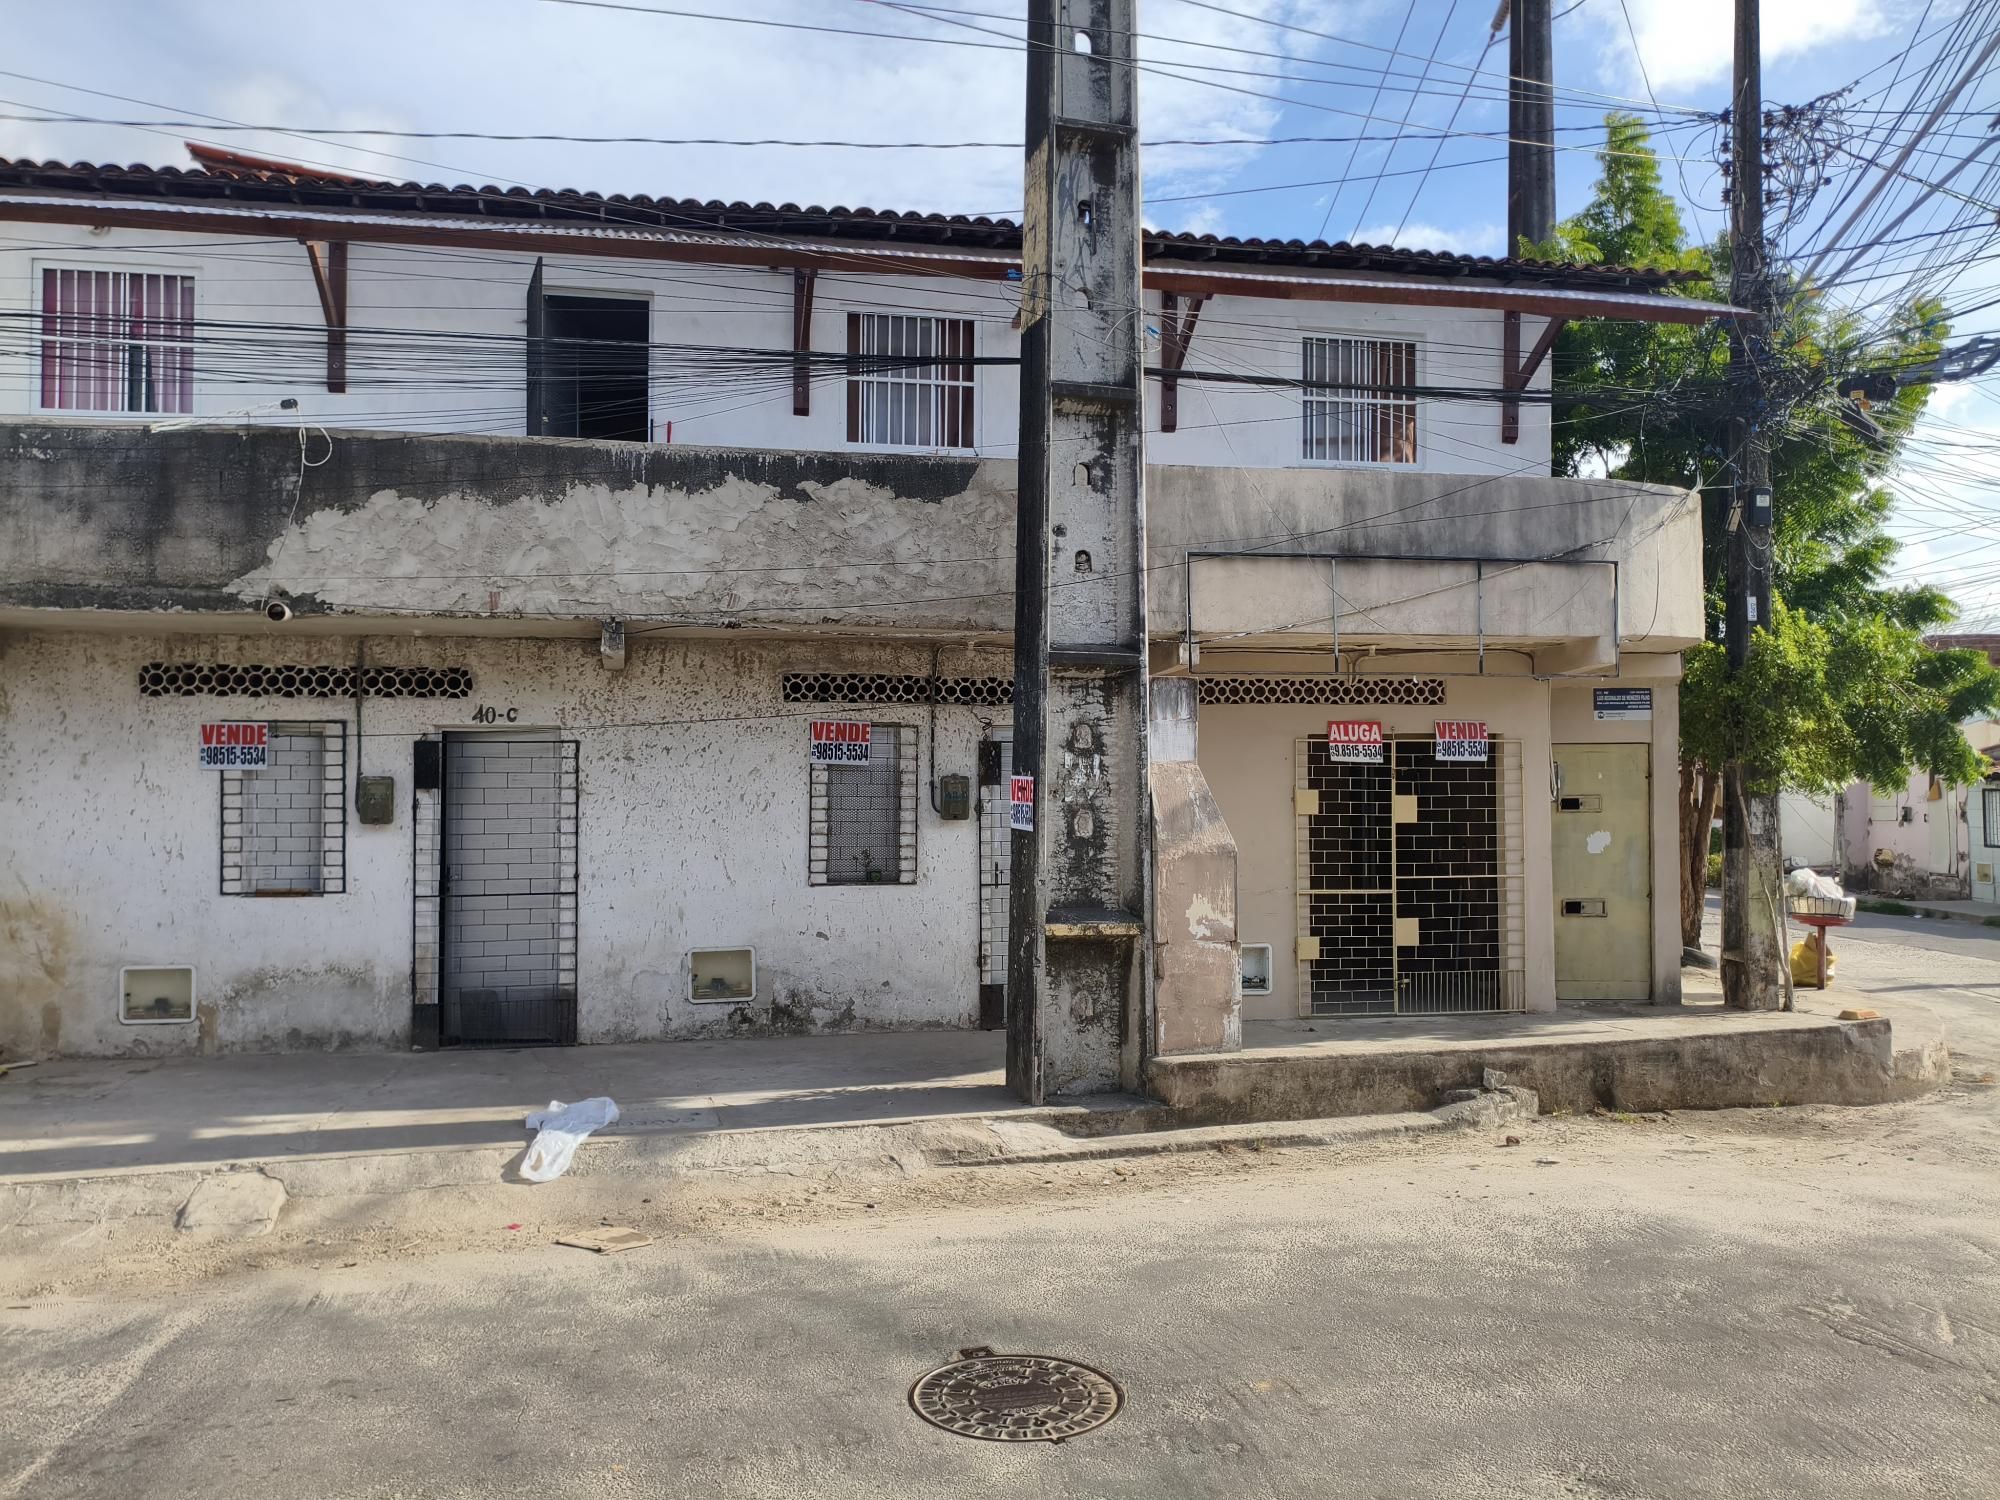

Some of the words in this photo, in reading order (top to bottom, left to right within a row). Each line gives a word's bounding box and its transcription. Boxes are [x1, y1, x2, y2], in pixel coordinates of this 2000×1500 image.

[201, 724, 267, 745] VENDE
[812, 722, 869, 742] VENDE
[1331, 724, 1380, 741] ALUGA
[1435, 722, 1488, 739] VENDE
[206, 746, 265, 765] 98515-5534
[816, 743, 868, 761] 98515-5534
[1441, 741, 1487, 757] 98515-5534
[1011, 779, 1033, 803] VENDE
